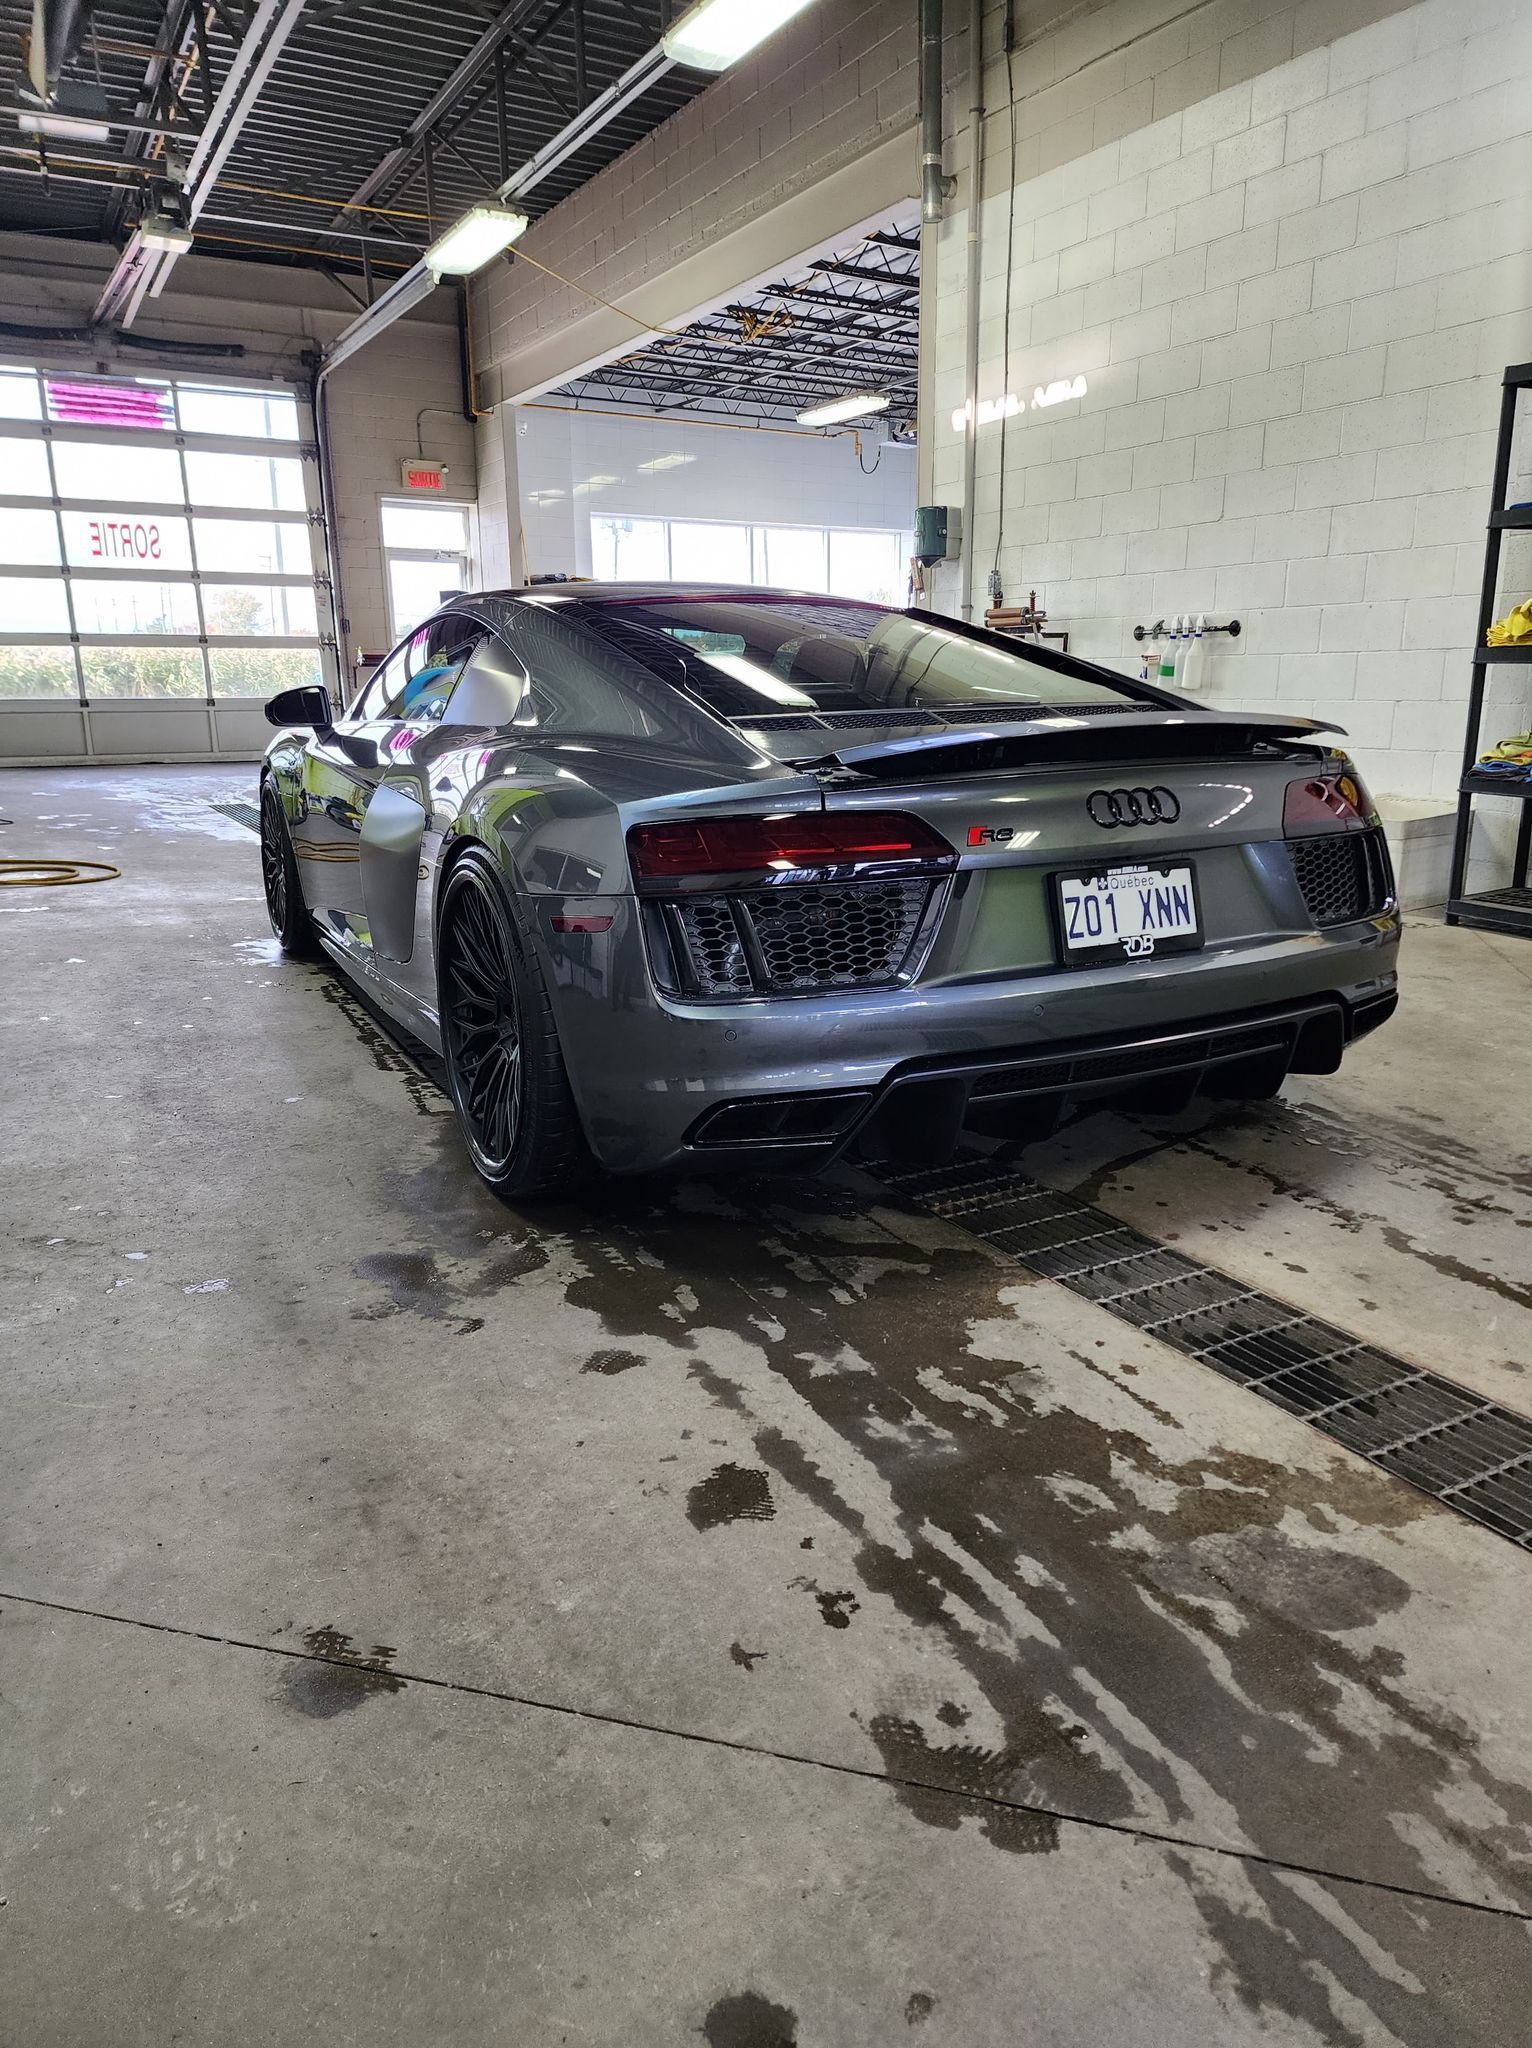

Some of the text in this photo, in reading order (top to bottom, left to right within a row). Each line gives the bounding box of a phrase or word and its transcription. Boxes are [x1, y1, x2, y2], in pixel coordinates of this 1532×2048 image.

[977, 827, 1014, 843] R8
[1110, 875, 1154, 889] Québec
[1065, 885, 1190, 939] Z01 XNN
[1120, 934, 1155, 957] RDB
